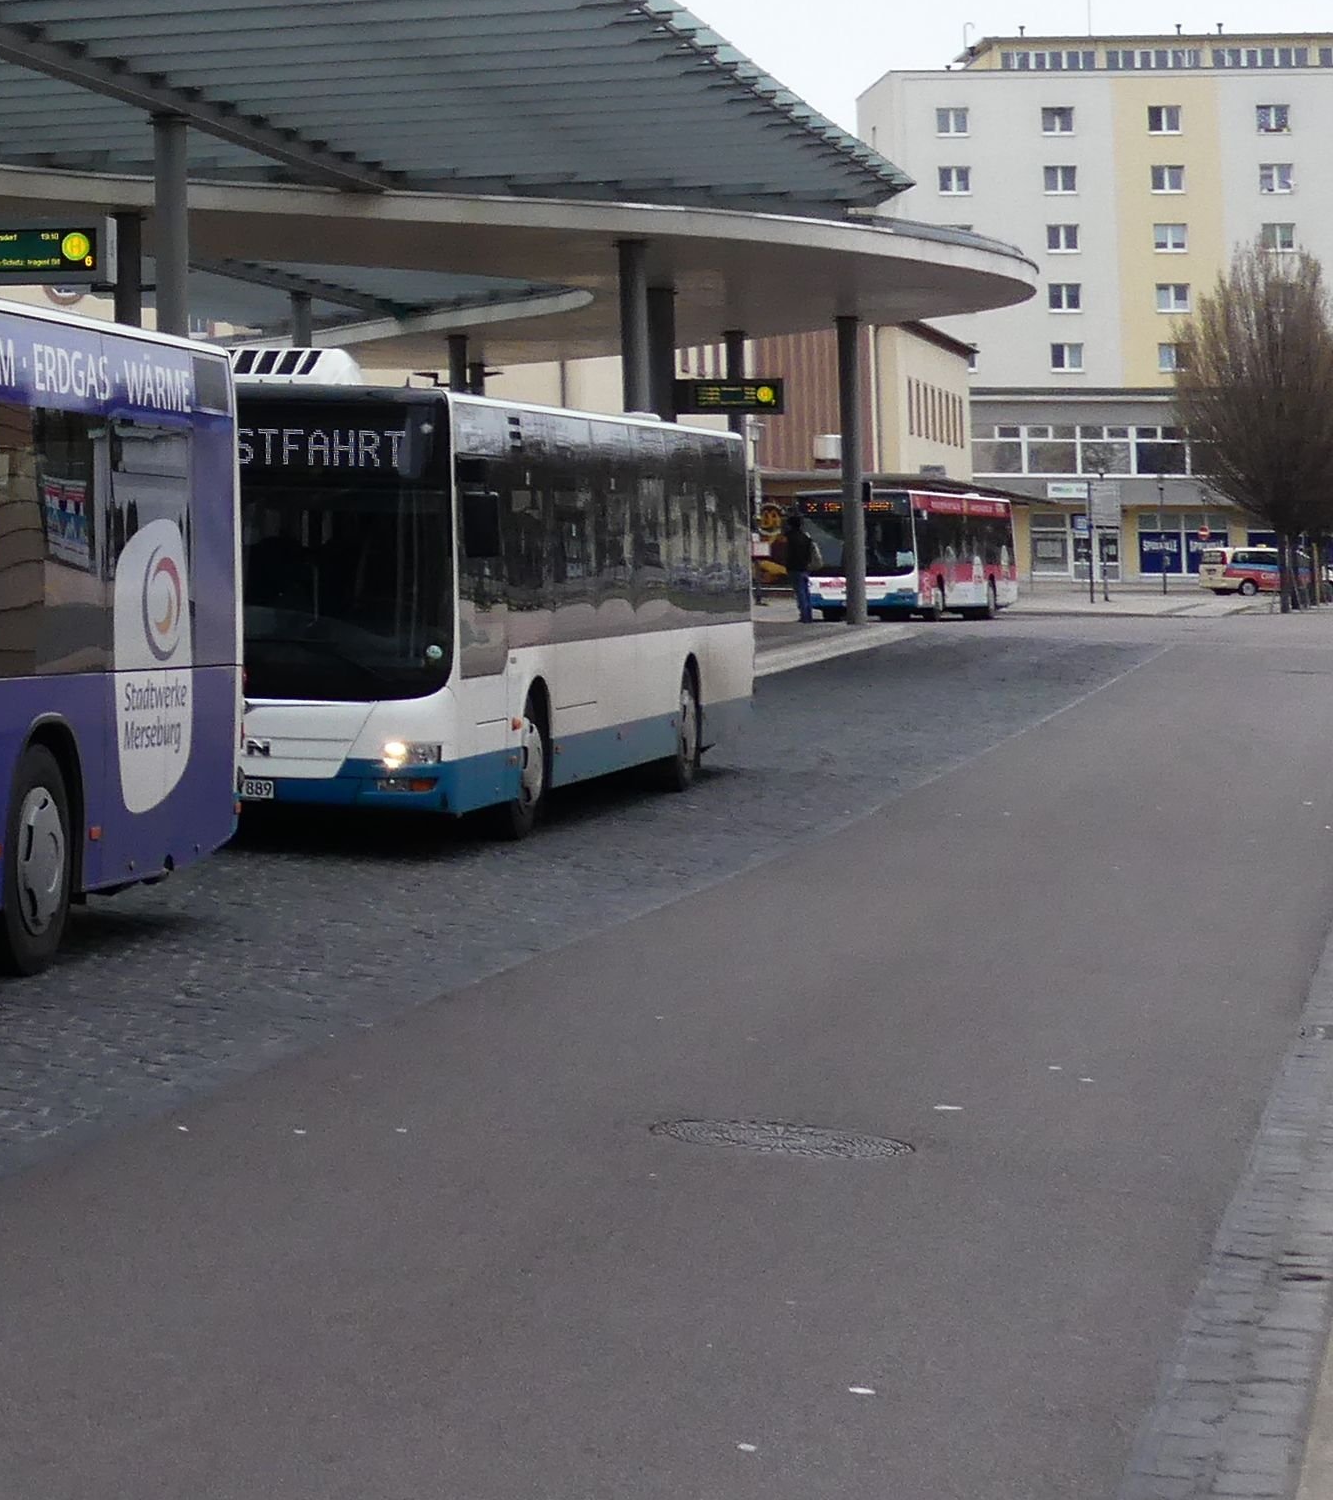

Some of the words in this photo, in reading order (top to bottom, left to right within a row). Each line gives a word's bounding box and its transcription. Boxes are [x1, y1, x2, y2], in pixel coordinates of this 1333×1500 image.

[84, 255, 93, 267] 6
[34, 343, 110, 401] ERDGAS
[123, 353, 193, 413] WÄRME
[123, 678, 188, 713] Stadtwerke
[123, 716, 182, 754] Merseburg
[244, 781, 273, 797] 889
